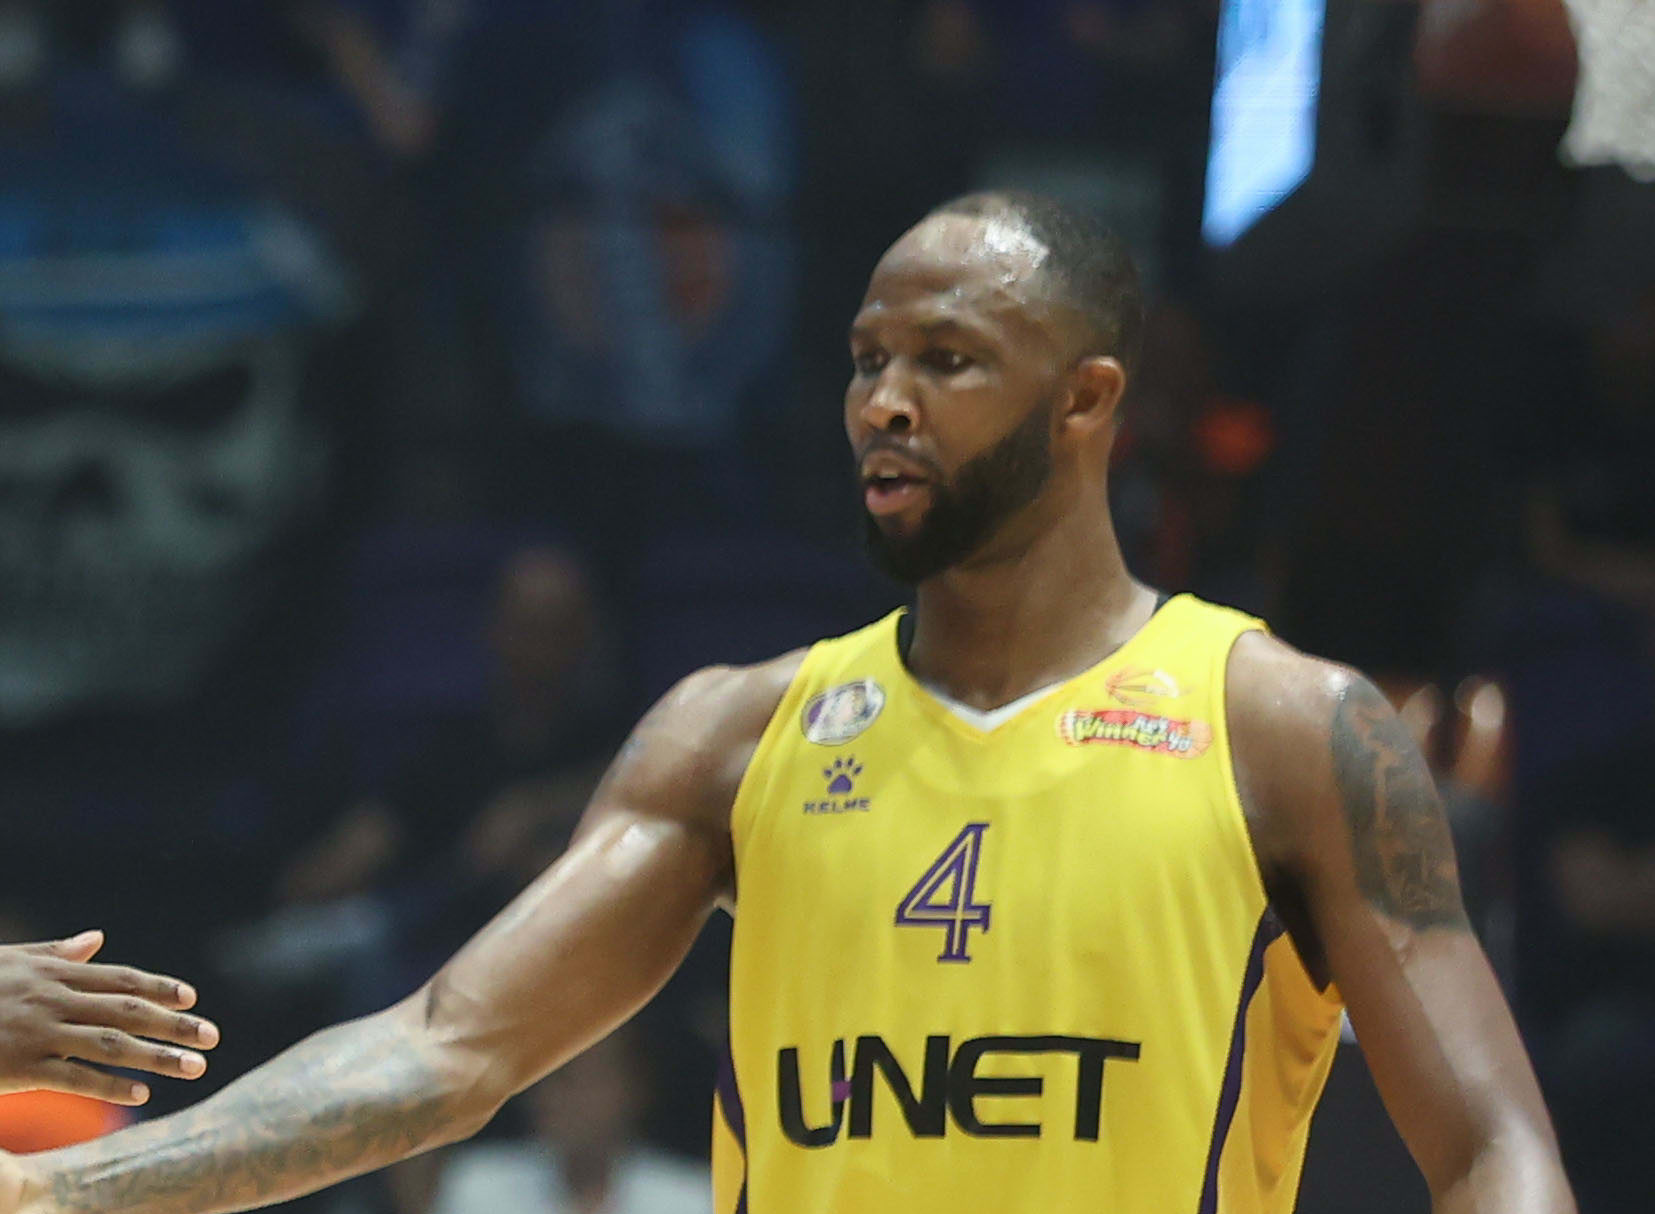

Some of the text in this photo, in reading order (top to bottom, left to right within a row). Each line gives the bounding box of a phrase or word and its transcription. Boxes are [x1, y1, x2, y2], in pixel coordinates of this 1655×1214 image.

[803, 798, 871, 814] KELME
[894, 823, 991, 962] 4
[778, 1034, 1142, 1147] UNET
